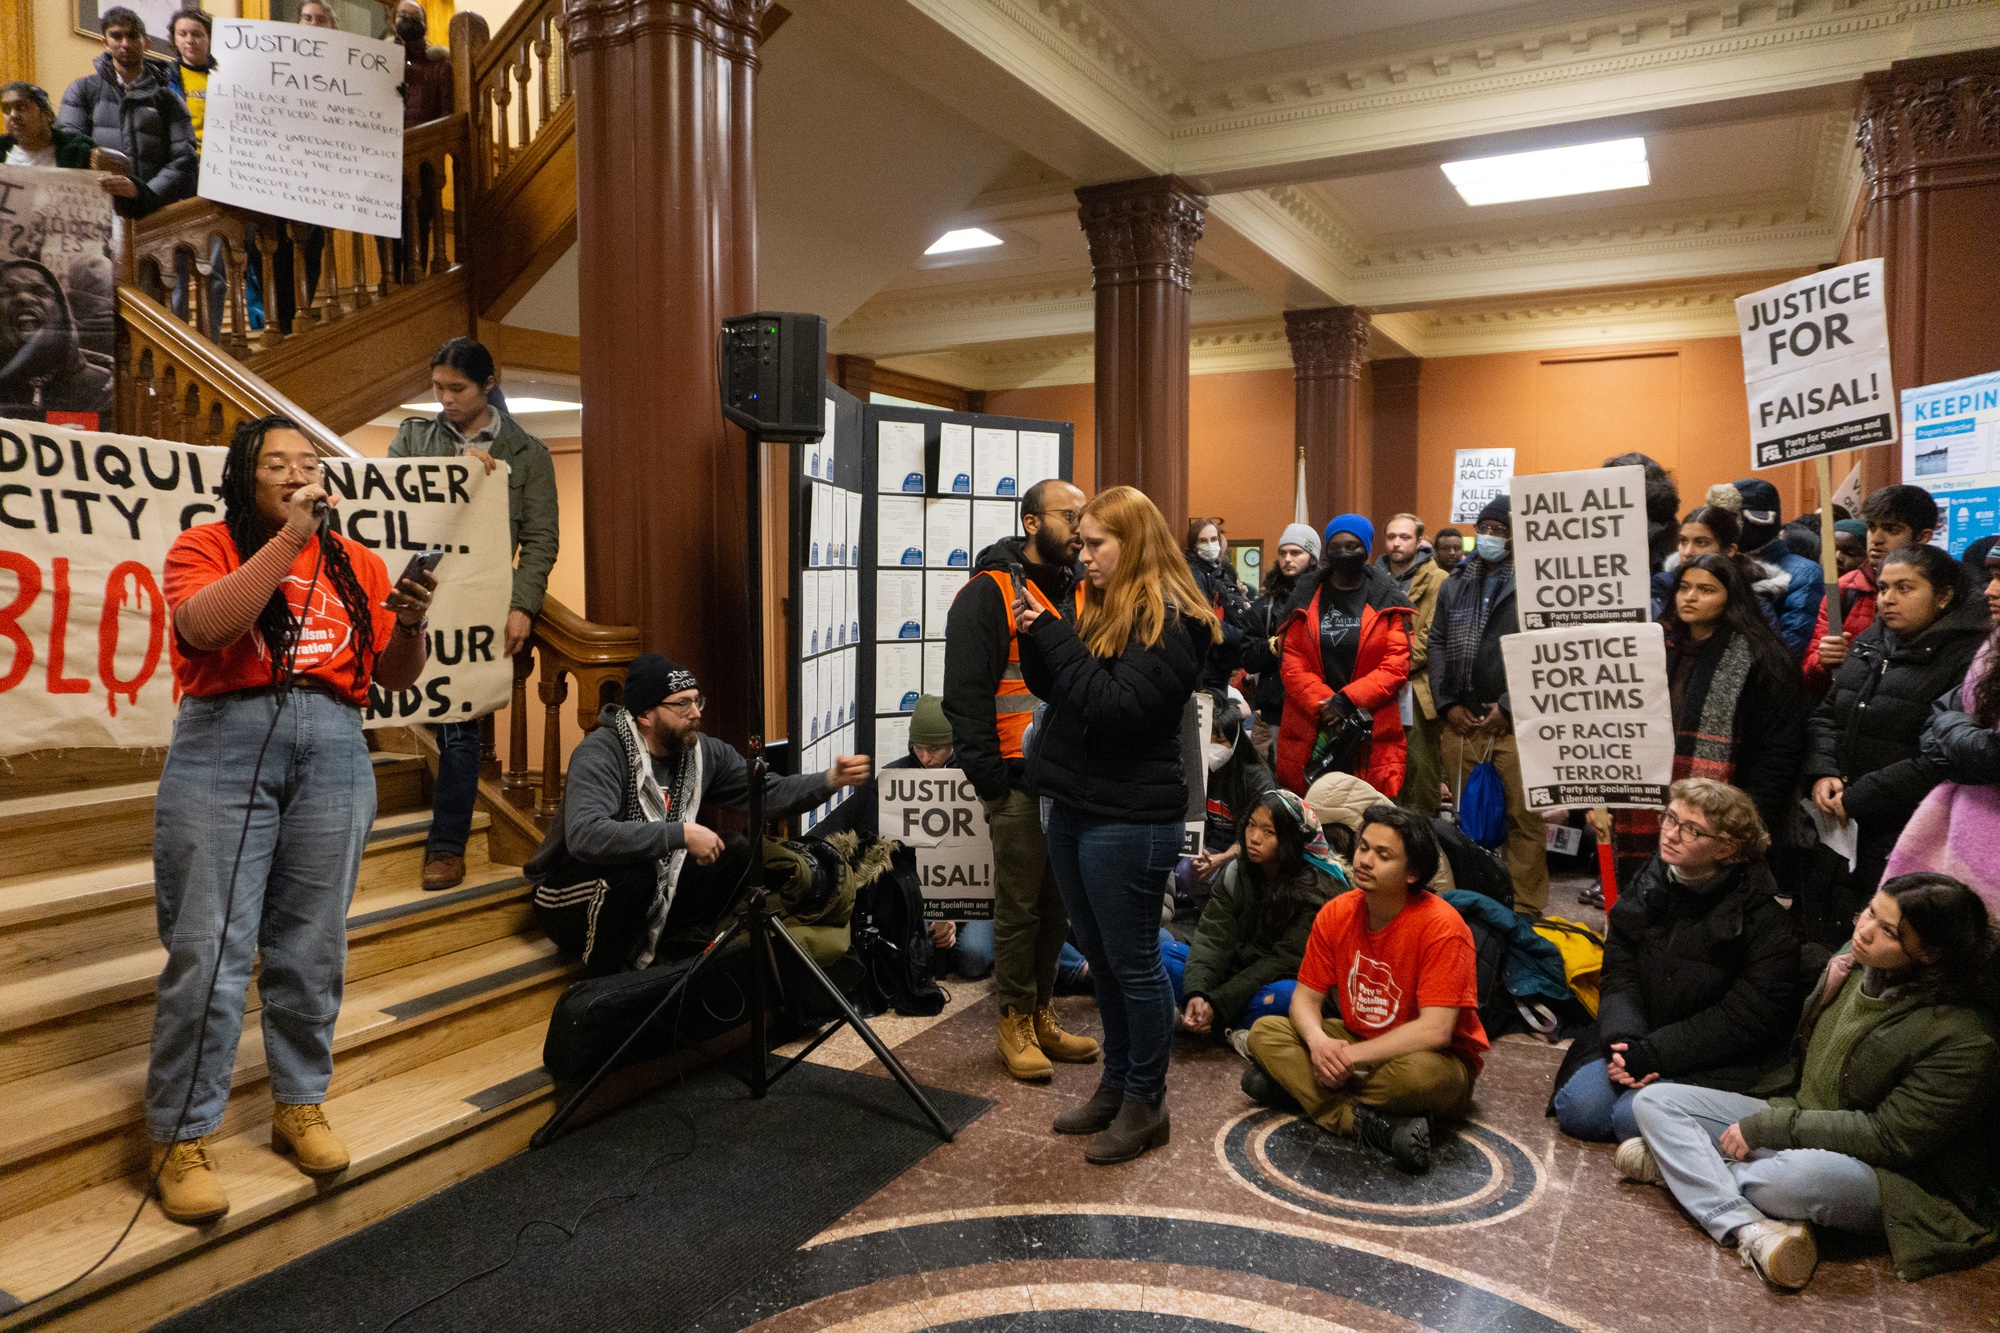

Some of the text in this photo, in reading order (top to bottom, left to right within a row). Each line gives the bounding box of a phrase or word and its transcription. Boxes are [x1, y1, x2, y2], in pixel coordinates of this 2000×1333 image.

[224, 25, 390, 73] JUSTICE FOR
[271, 61, 362, 96] FAISAL
[232, 84, 288, 104] RELEASE
[299, 99, 318, 108] THE
[327, 103, 366, 118] NAMES
[370, 111, 382, 119] OF
[235, 102, 402, 137] THE OFFICERS WHO MURDERED
[235, 113, 276, 127] FAISAL
[230, 120, 277, 137] RELEASE
[286, 134, 356, 152] UNREDACTED
[361, 145, 398, 159] POLICE
[230, 135, 358, 162] REPORT OF INCIDENT
[229, 145, 256, 158] FIRE
[265, 153, 285, 162] ALL
[291, 158, 304, 167] OF
[312, 161, 330, 172] THE
[339, 167, 393, 182] OFFICERS
[230, 159, 308, 179] IMMEDIATELY
[229, 168, 290, 189] PROSECUTE
[298, 185, 351, 199] OFFICERS
[355, 195, 402, 211] INVOLVED
[230, 181, 397, 220] TO FULL EXTENT OF THE LAW
[1748, 272, 1870, 331] JUSTICE
[1769, 313, 1855, 365] FOR
[1760, 373, 1880, 428] FAISAL!
[1915, 389, 1998, 421] KEEPIN
[1761, 418, 1881, 462] PSL Party for Socialism and
[1785, 443, 1826, 458] Liberation
[1460, 457, 1509, 468] JAIL ALL
[1460, 470, 1504, 480] RACIST
[0, 484, 148, 540] CITY
[1521, 486, 1634, 516] JAIL ALL
[1525, 515, 1624, 542] RACIST
[1535, 553, 1631, 581] KILLER
[1536, 581, 1624, 608] COPS!
[1335, 617, 1353, 625] MIT
[1527, 617, 1545, 627] PSL
[1550, 612, 1569, 621] Party
[1582, 611, 1620, 619] Socialism
[1622, 610, 1637, 618] and
[0, 550, 182, 717] BLO
[426, 625, 494, 665] UR
[1531, 636, 1638, 665] JUSTICE
[1532, 662, 1645, 689] FOR ALL
[1530, 688, 1644, 714] VICTIMS
[1539, 723, 1648, 741] OF RACIST
[1559, 744, 1633, 760] POLICE
[1552, 764, 1643, 781] TERROR!
[884, 779, 977, 802] JUSTIC
[1531, 793, 1554, 805] PSL
[1560, 785, 1583, 795] Party
[1600, 785, 1643, 794] Socialism
[1645, 785, 1661, 794] and
[1561, 795, 1605, 804] Liberation
[903, 808, 977, 837] FOR
[919, 864, 990, 887] ISAL!
[941, 901, 975, 909] Socialism
[976, 901, 989, 909] and
